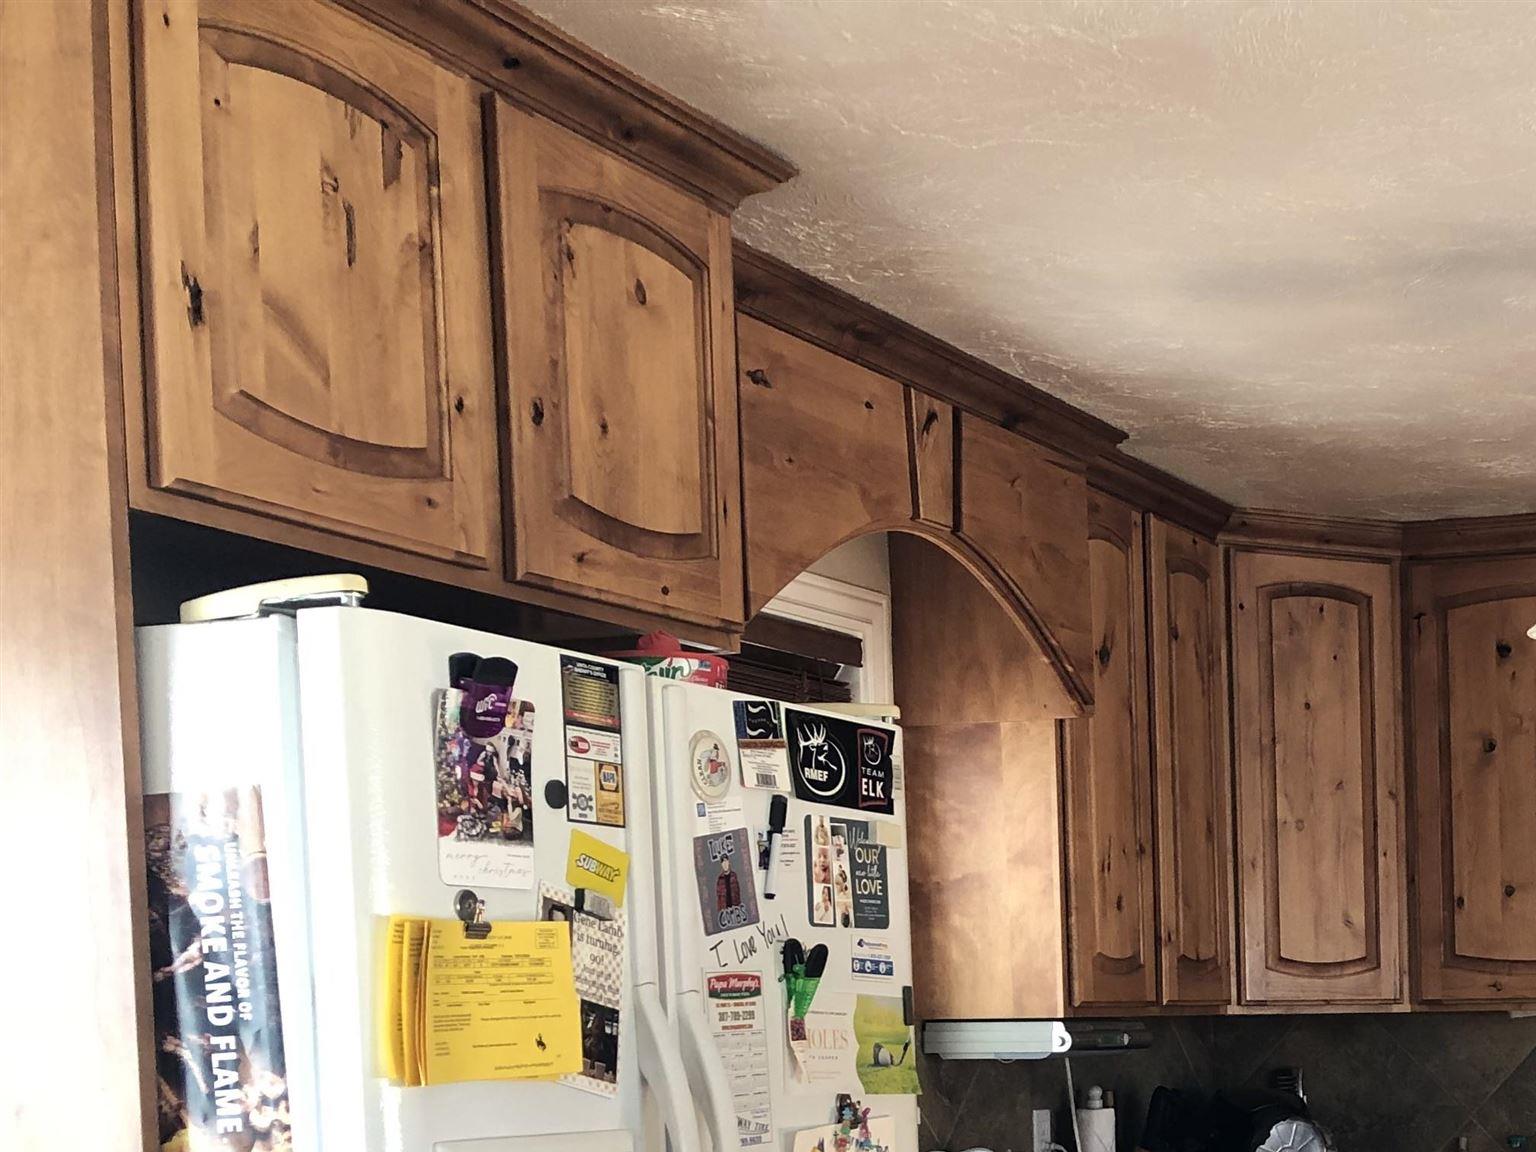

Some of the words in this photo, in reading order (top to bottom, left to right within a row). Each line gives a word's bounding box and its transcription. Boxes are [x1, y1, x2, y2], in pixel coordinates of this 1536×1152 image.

[804, 767, 829, 782] RMEF
[861, 766, 885, 778] TEAM
[861, 778, 885, 799] ELK
[707, 833, 735, 862] LUKE
[855, 846, 880, 865] OUR
[575, 852, 621, 883] SUBWAY
[192, 842, 228, 954] SMOKE
[855, 879, 883, 896] LOVE
[229, 910, 245, 939] THE
[718, 903, 749, 930] COMBS
[576, 933, 585, 942] is
[709, 939, 728, 968] I
[733, 935, 757, 965] Love
[231, 943, 252, 1001] FLAVOR
[202, 961, 236, 1027] AND
[235, 1001, 253, 1021] OF
[209, 1035, 244, 1136] FLAME
